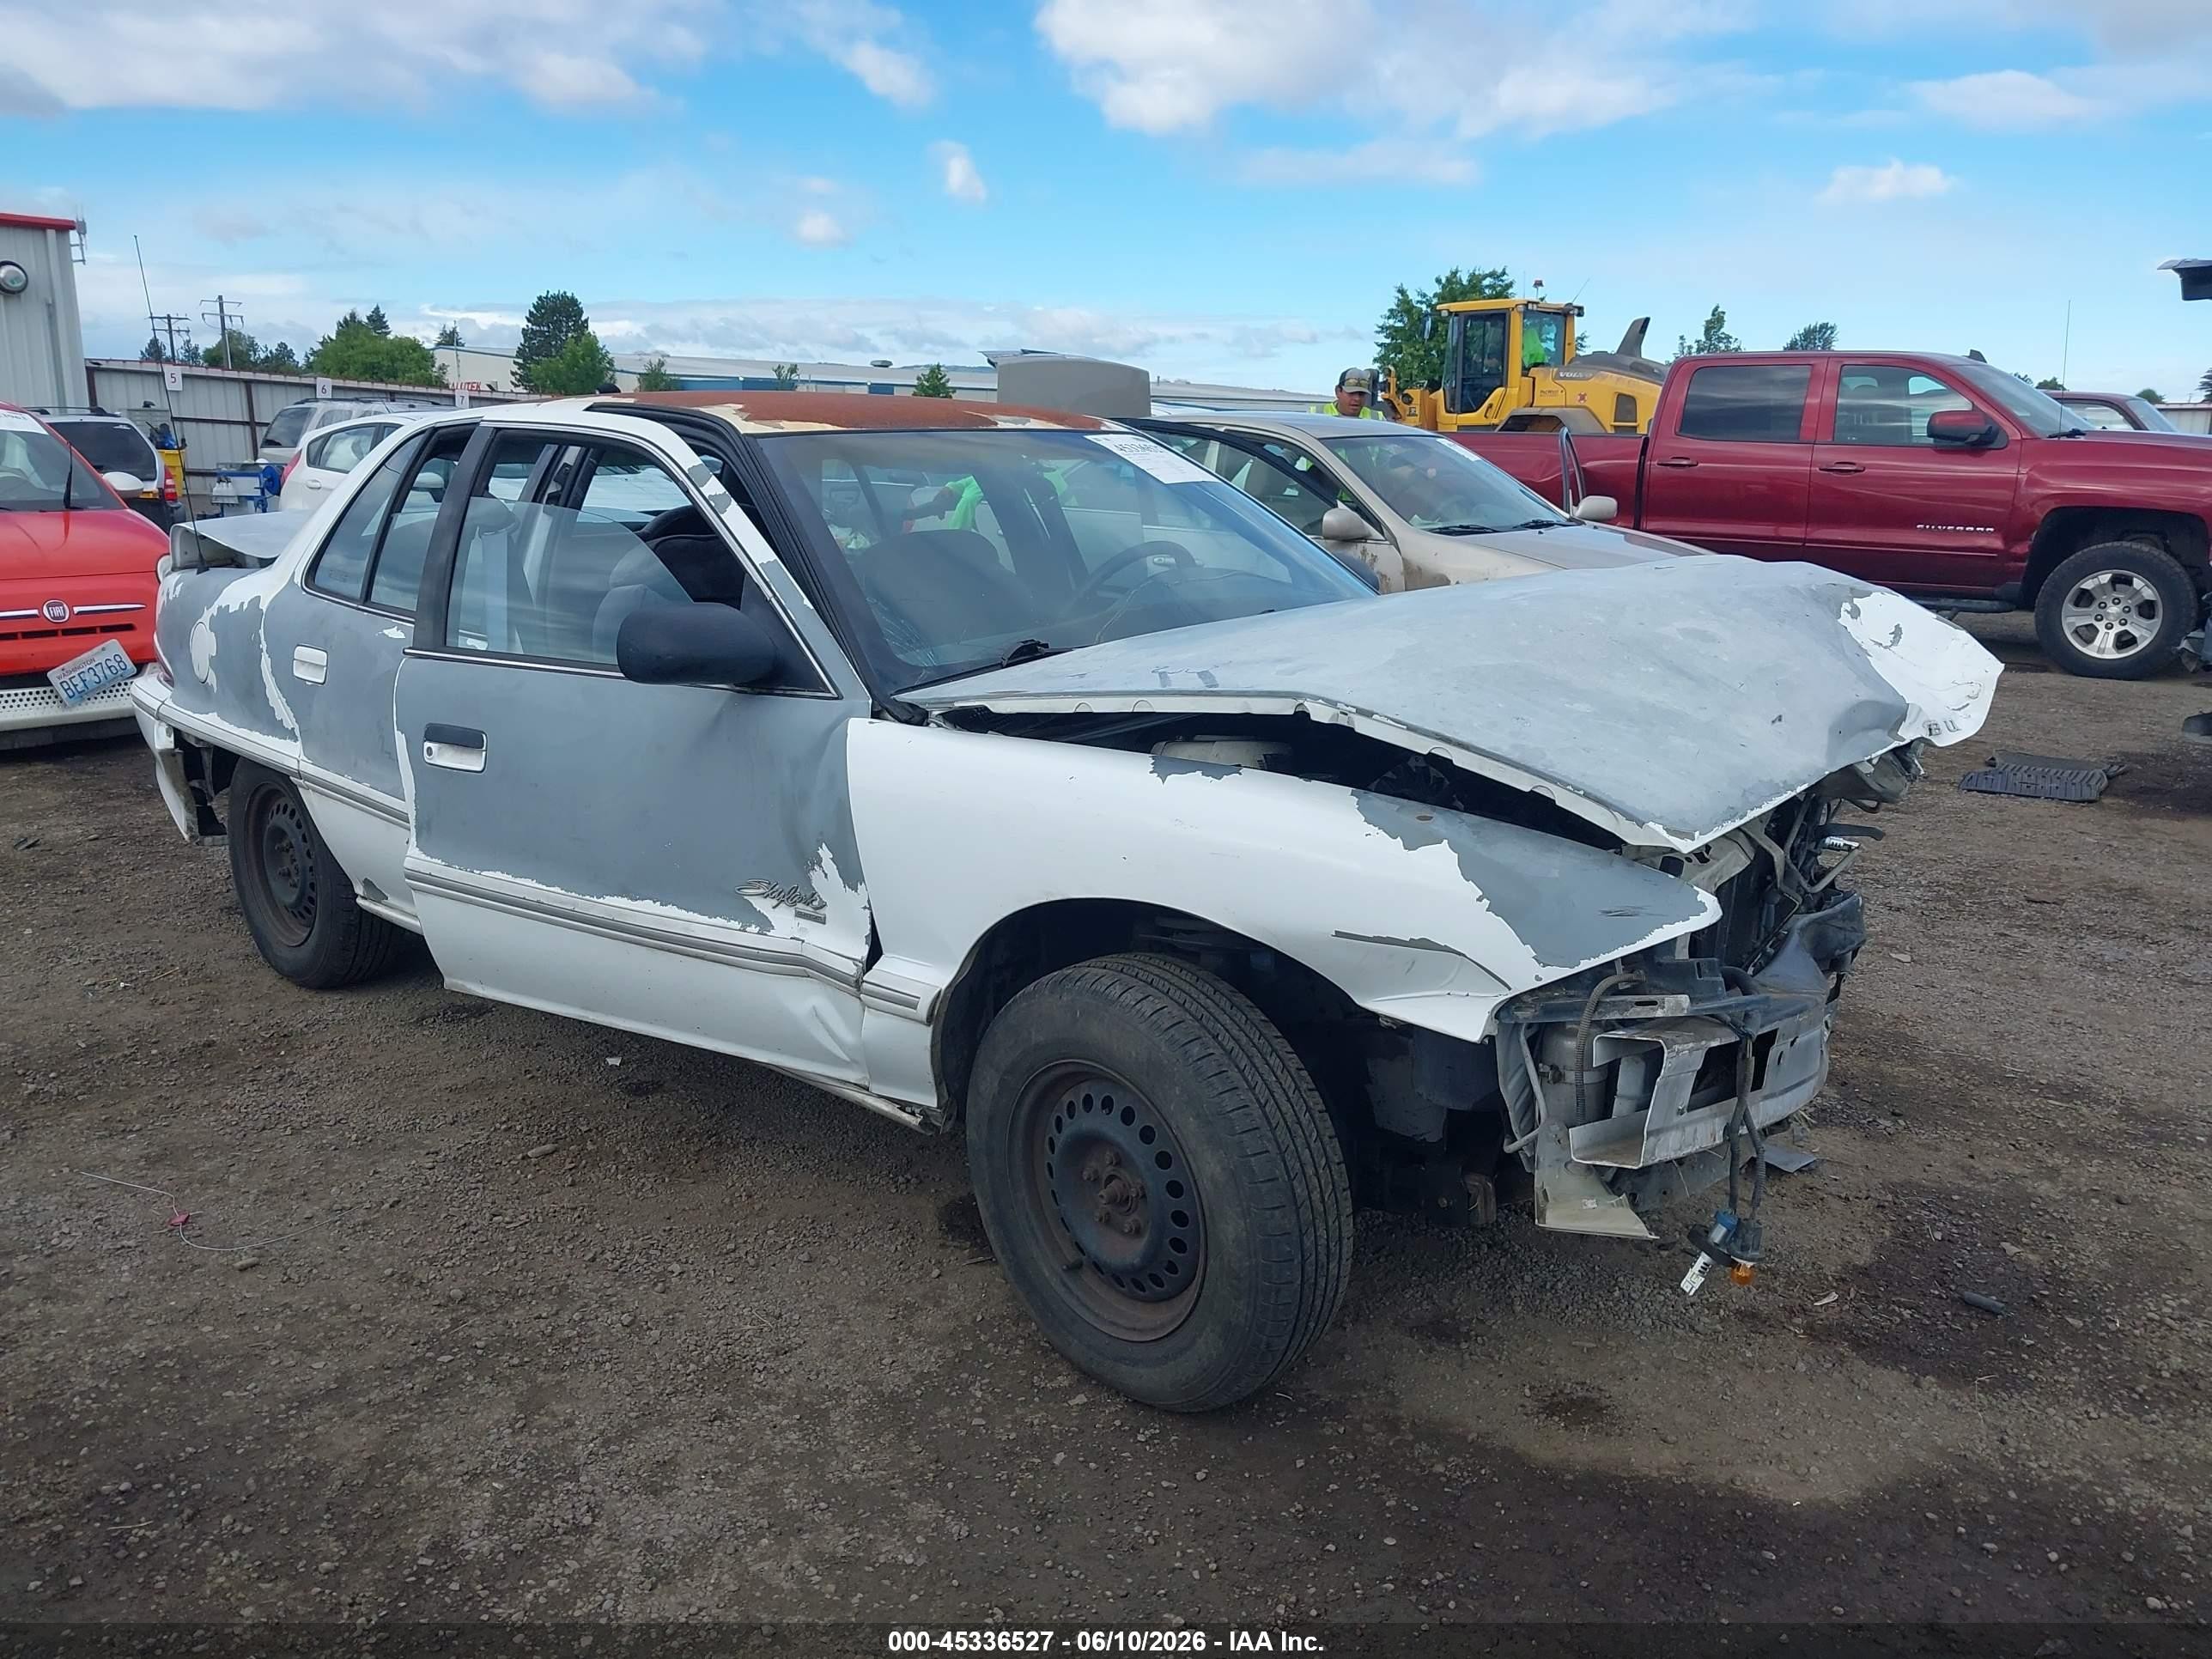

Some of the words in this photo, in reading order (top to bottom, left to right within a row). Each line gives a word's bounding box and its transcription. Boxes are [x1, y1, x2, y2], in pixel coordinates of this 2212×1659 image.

[170, 373, 177, 384] 5
[321, 385, 327, 394] 6
[459, 395, 465, 404] 7
[48, 605, 65, 617] FIAT
[55, 657, 97, 681] WASHINGTON
[58, 653, 128, 699] BEF3768
[735, 878, 828, 910] Skylark
